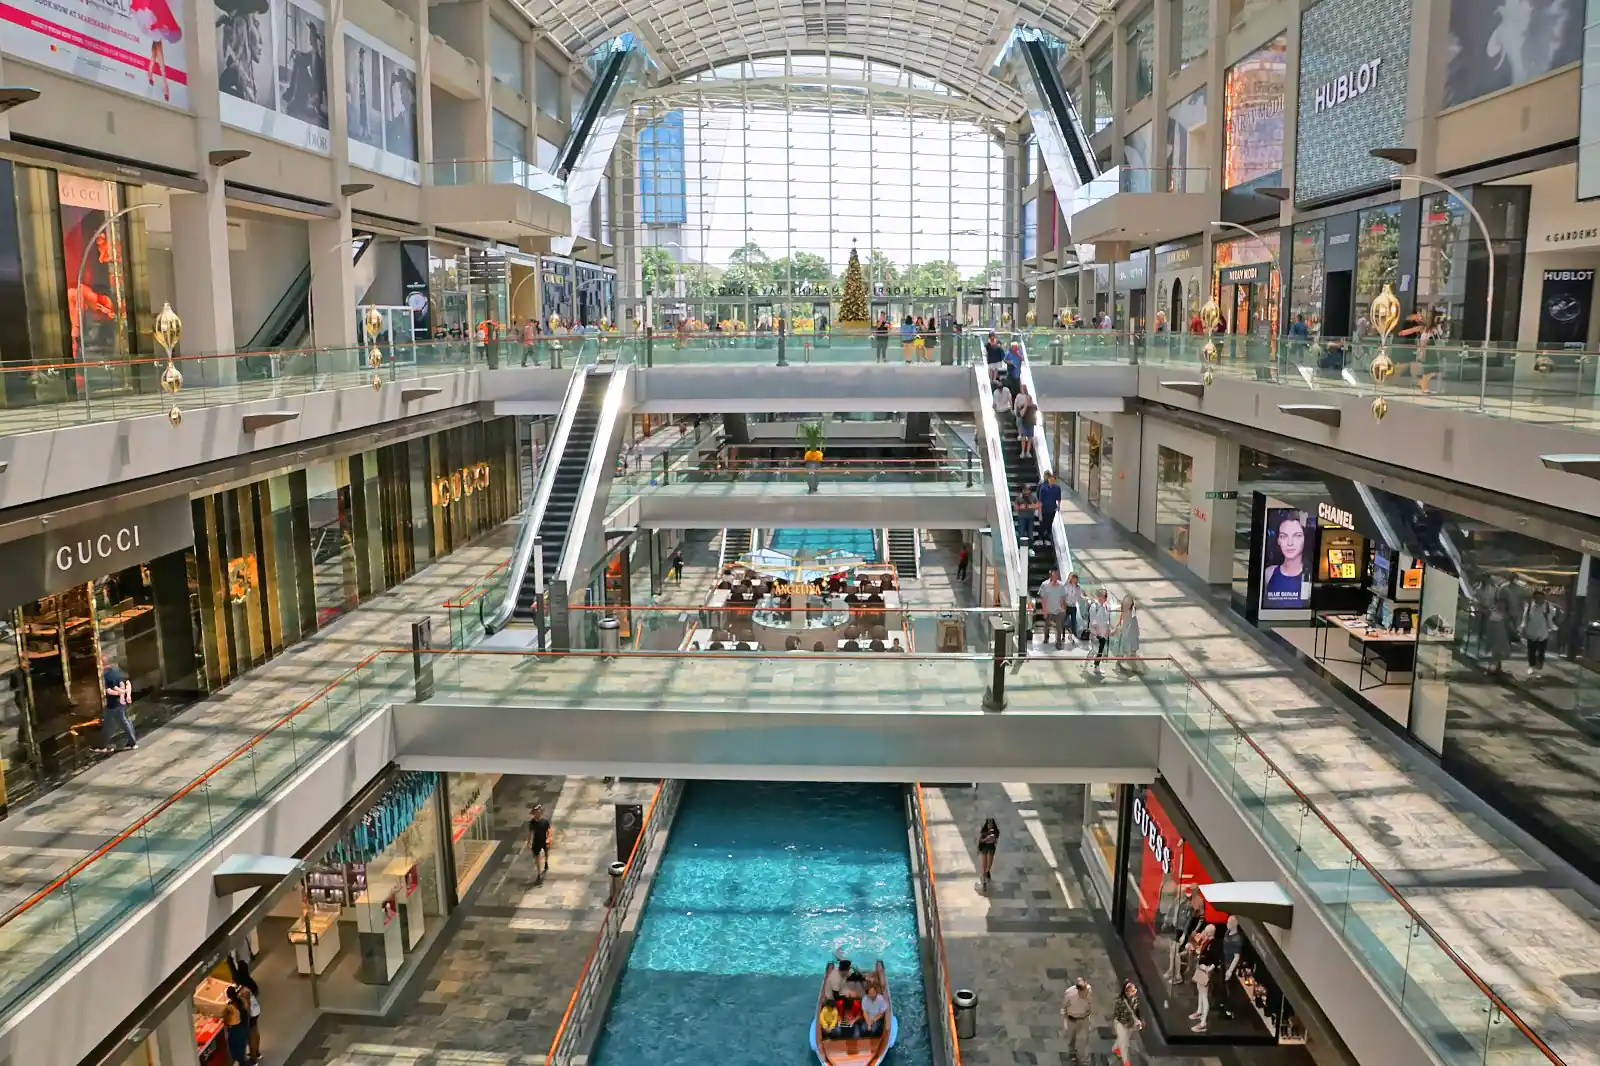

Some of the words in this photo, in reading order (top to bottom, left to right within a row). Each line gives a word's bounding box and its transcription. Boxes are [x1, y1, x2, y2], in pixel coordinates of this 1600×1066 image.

[1315, 57, 1381, 114] HUBLOT
[1552, 228, 1598, 242] GARDENS
[1543, 271, 1594, 281] HUBLOT
[1318, 502, 1355, 531] CHANEL
[56, 525, 140, 571] GUCCI
[775, 584, 822, 597] ANGELINA
[1134, 798, 1170, 875] GUESS
